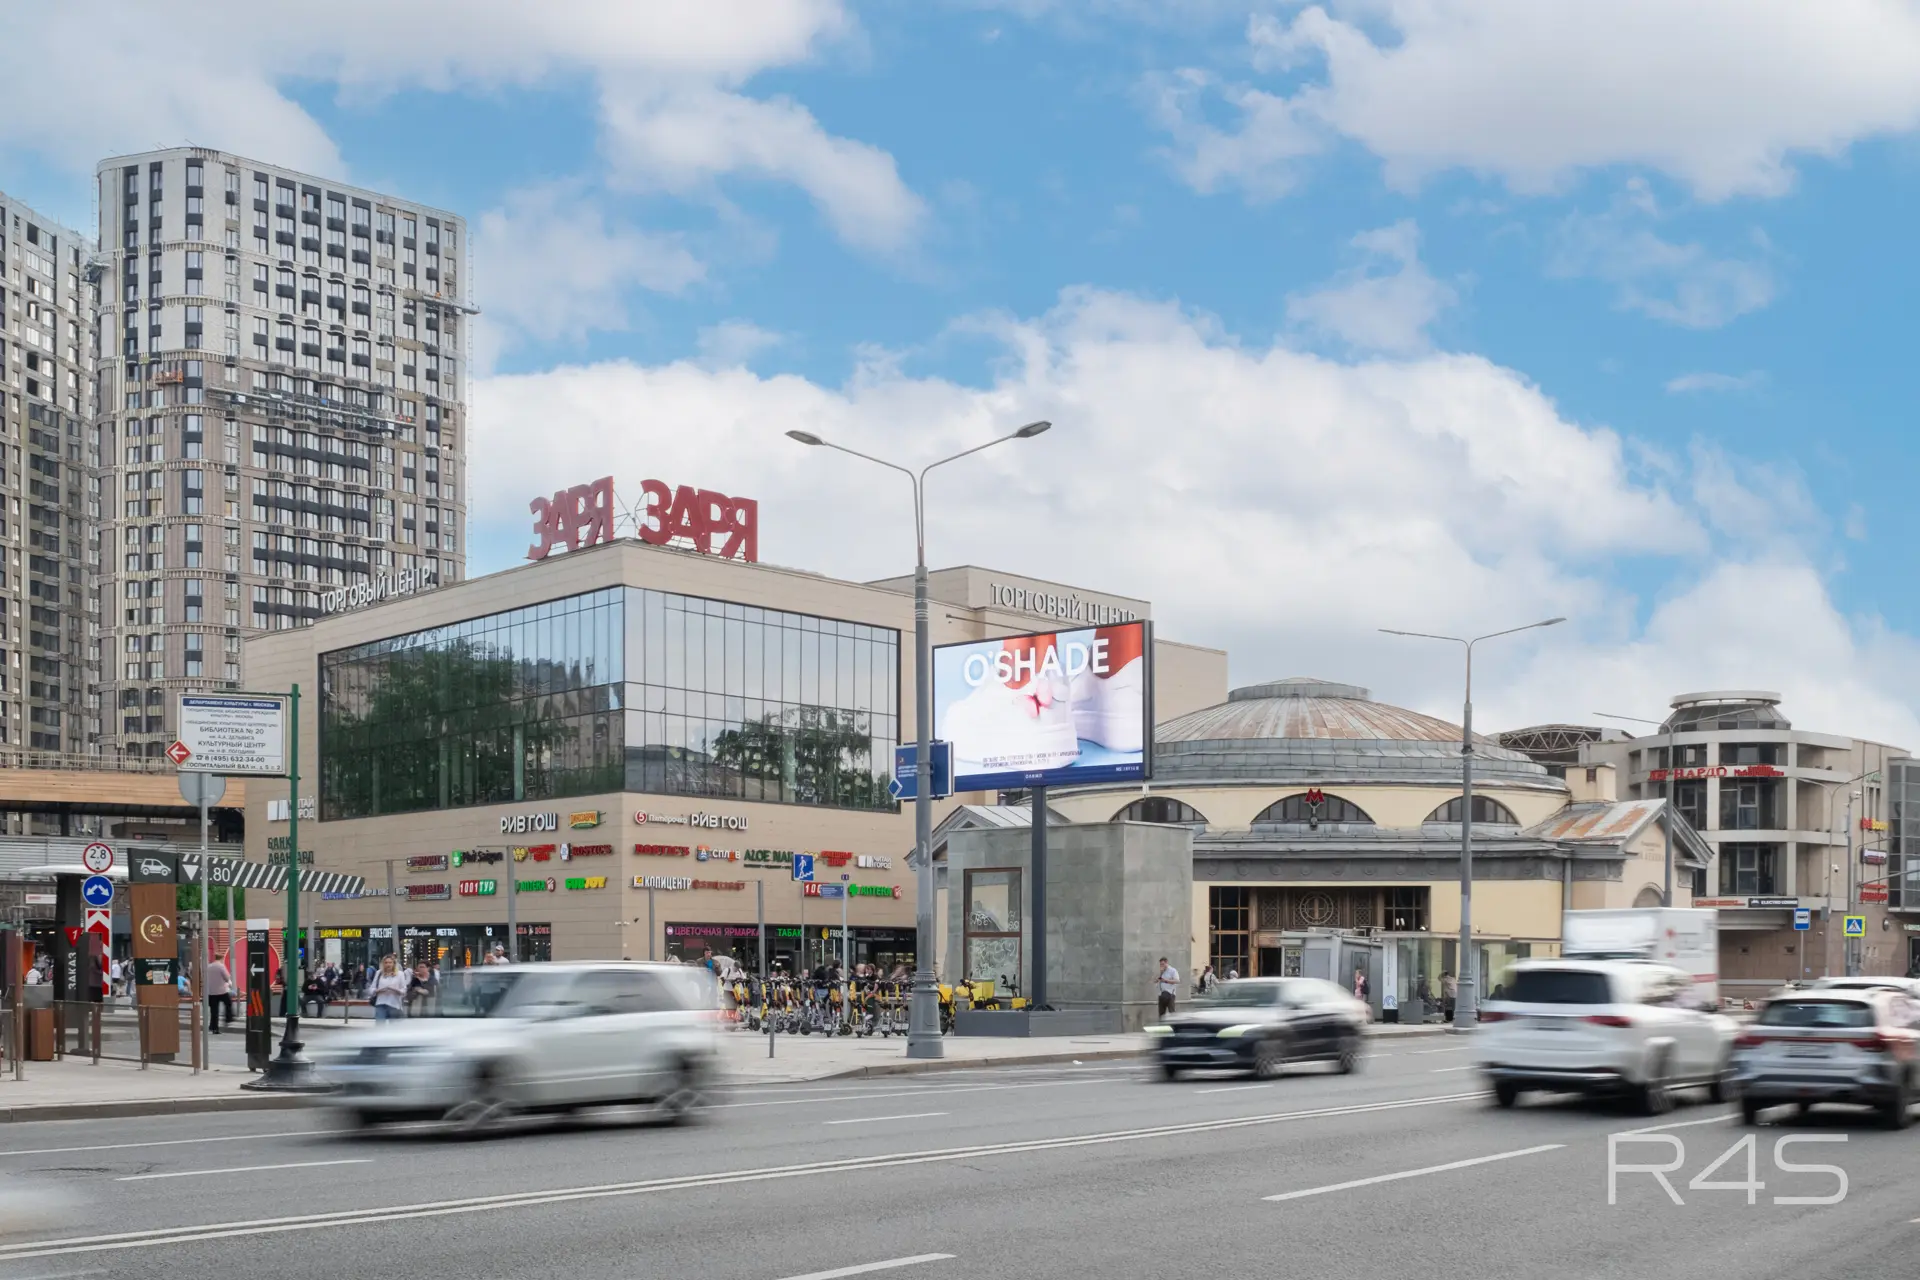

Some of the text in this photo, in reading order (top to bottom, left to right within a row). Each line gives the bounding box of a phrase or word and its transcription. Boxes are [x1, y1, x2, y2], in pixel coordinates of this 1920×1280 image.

[528, 476, 614, 560] ЗАРЯ
[638, 479, 757, 563] ЗАРЯ
[320, 565, 432, 614] ТОРГОВЫЙ ЦЕНТР
[990, 583, 1082, 621] ТОРГОВЫЙ
[964, 639, 1109, 688] O'SHADE
[198, 740, 242, 748] КУЛЬТУРНЫЙ
[230, 755, 265, 763] 632-34-00
[1649, 767, 1728, 782] ЛЕНАРДО
[500, 812, 558, 834] РИВ ГОШ
[691, 813, 749, 830] РИВ ГОШ
[90, 848, 107, 860] 2.8
[268, 850, 314, 865] АВАНАРД
[744, 849, 771, 862] ALOE
[460, 880, 495, 894] 1001 ТУР
[645, 876, 692, 891] КОПИЦЕНТР
[860, 884, 892, 896] АПТЕКА
[150, 923, 163, 933] 24
[675, 926, 760, 938] ЦВЕТОЧНАЯ ЯРМАРКА
[777, 928, 803, 937] ТАБАК
[247, 932, 265, 943] ВЪЕЗД
[68, 951, 77, 990] ЗАКАЗ
